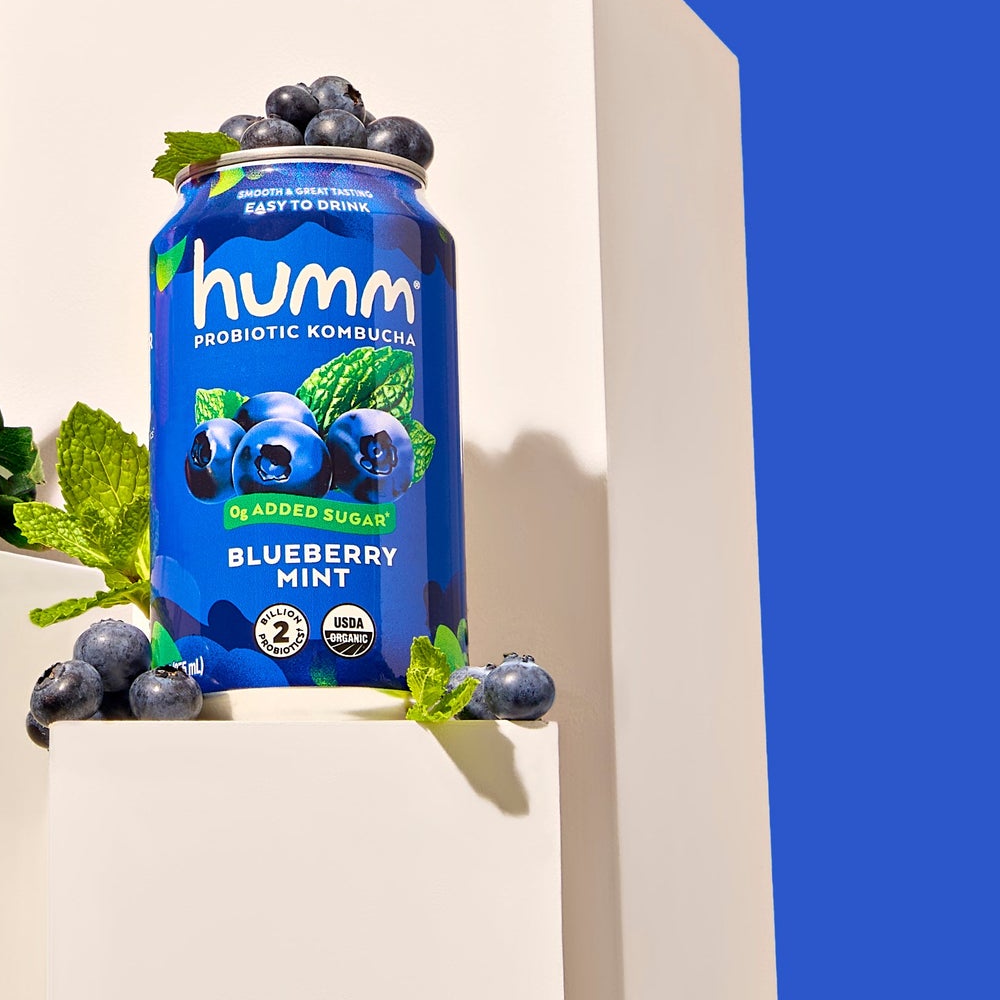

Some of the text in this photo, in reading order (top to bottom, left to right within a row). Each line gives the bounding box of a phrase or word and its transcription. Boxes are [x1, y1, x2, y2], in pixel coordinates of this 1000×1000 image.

[237, 187, 373, 199] SMOOTH & GREAT TASTING
[244, 199, 370, 213] EASY TO DRINK
[194, 324, 416, 349] PROBIOTIC KOMBUCHA
[229, 505, 248, 521] 0g
[252, 502, 318, 518] ADDED
[228, 543, 397, 568] BLUEBERRY
[277, 567, 350, 588] MINT
[260, 608, 302, 625] BILLION
[334, 616, 364, 629] USDA
[273, 620, 289, 643] 2
[330, 633, 368, 644] ORGANIC
[188, 656, 204, 676] mL)
